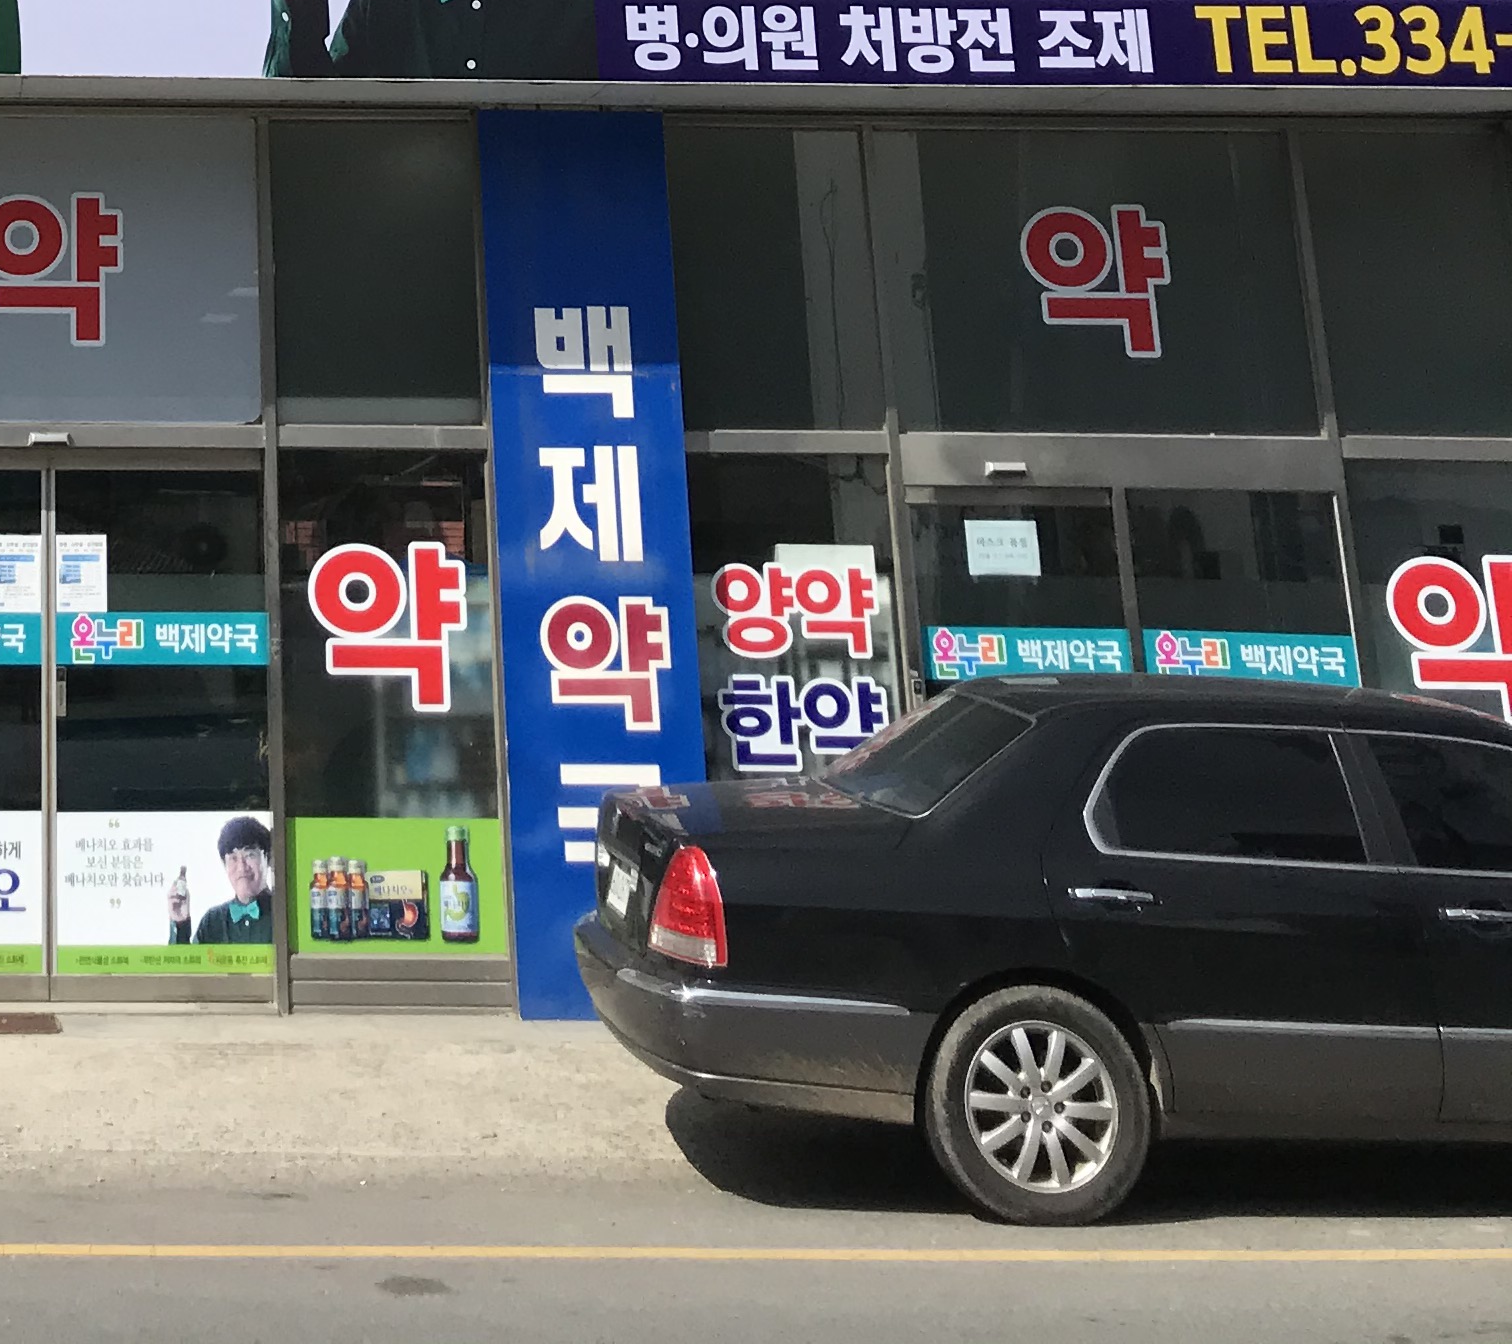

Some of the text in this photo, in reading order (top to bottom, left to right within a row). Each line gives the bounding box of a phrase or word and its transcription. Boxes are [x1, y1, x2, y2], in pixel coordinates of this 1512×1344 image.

[839, 5, 1017, 75] 처방전
[1037, 6, 1154, 75] 조제
[1019, 203, 1172, 358] 약
[69, 612, 260, 665] 온누리 백제약국
[307, 540, 468, 713] 약
[710, 560, 881, 660] 양약
[931, 627, 1124, 683] 온누리 백제약국
[1155, 629, 1347, 679] 온누리 백제약국
